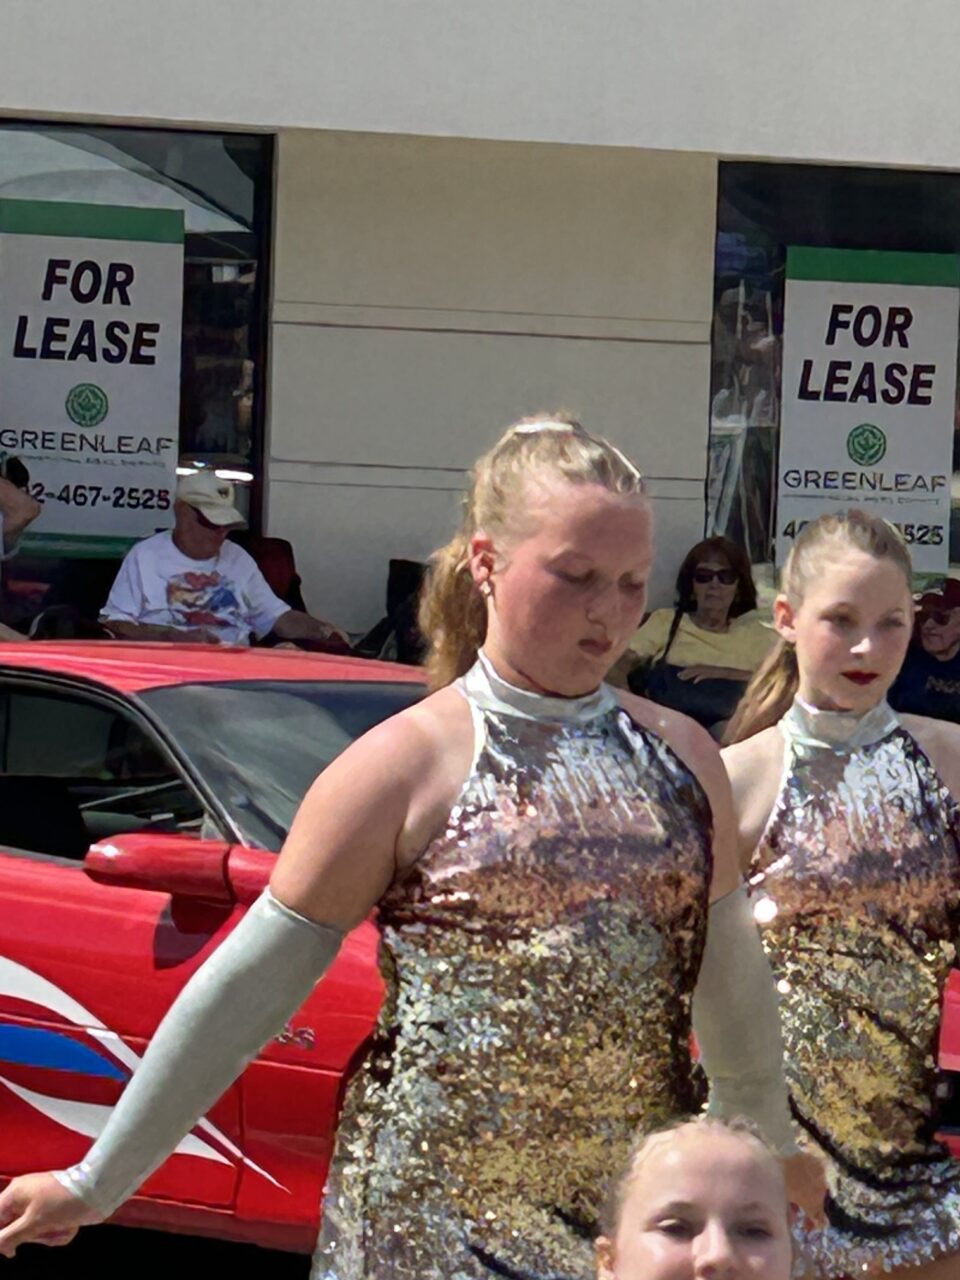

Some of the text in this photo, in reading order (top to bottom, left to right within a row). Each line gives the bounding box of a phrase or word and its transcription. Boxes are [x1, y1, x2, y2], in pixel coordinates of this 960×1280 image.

[41, 258, 135, 306] FOR
[13, 315, 160, 366] LEASE
[825, 304, 914, 348] FOR
[797, 359, 936, 406] LEASE
[0, 429, 174, 455] GREENLEAF
[27, 482, 171, 510] 2-467-2525
[783, 469, 947, 493] GREENLEAF
